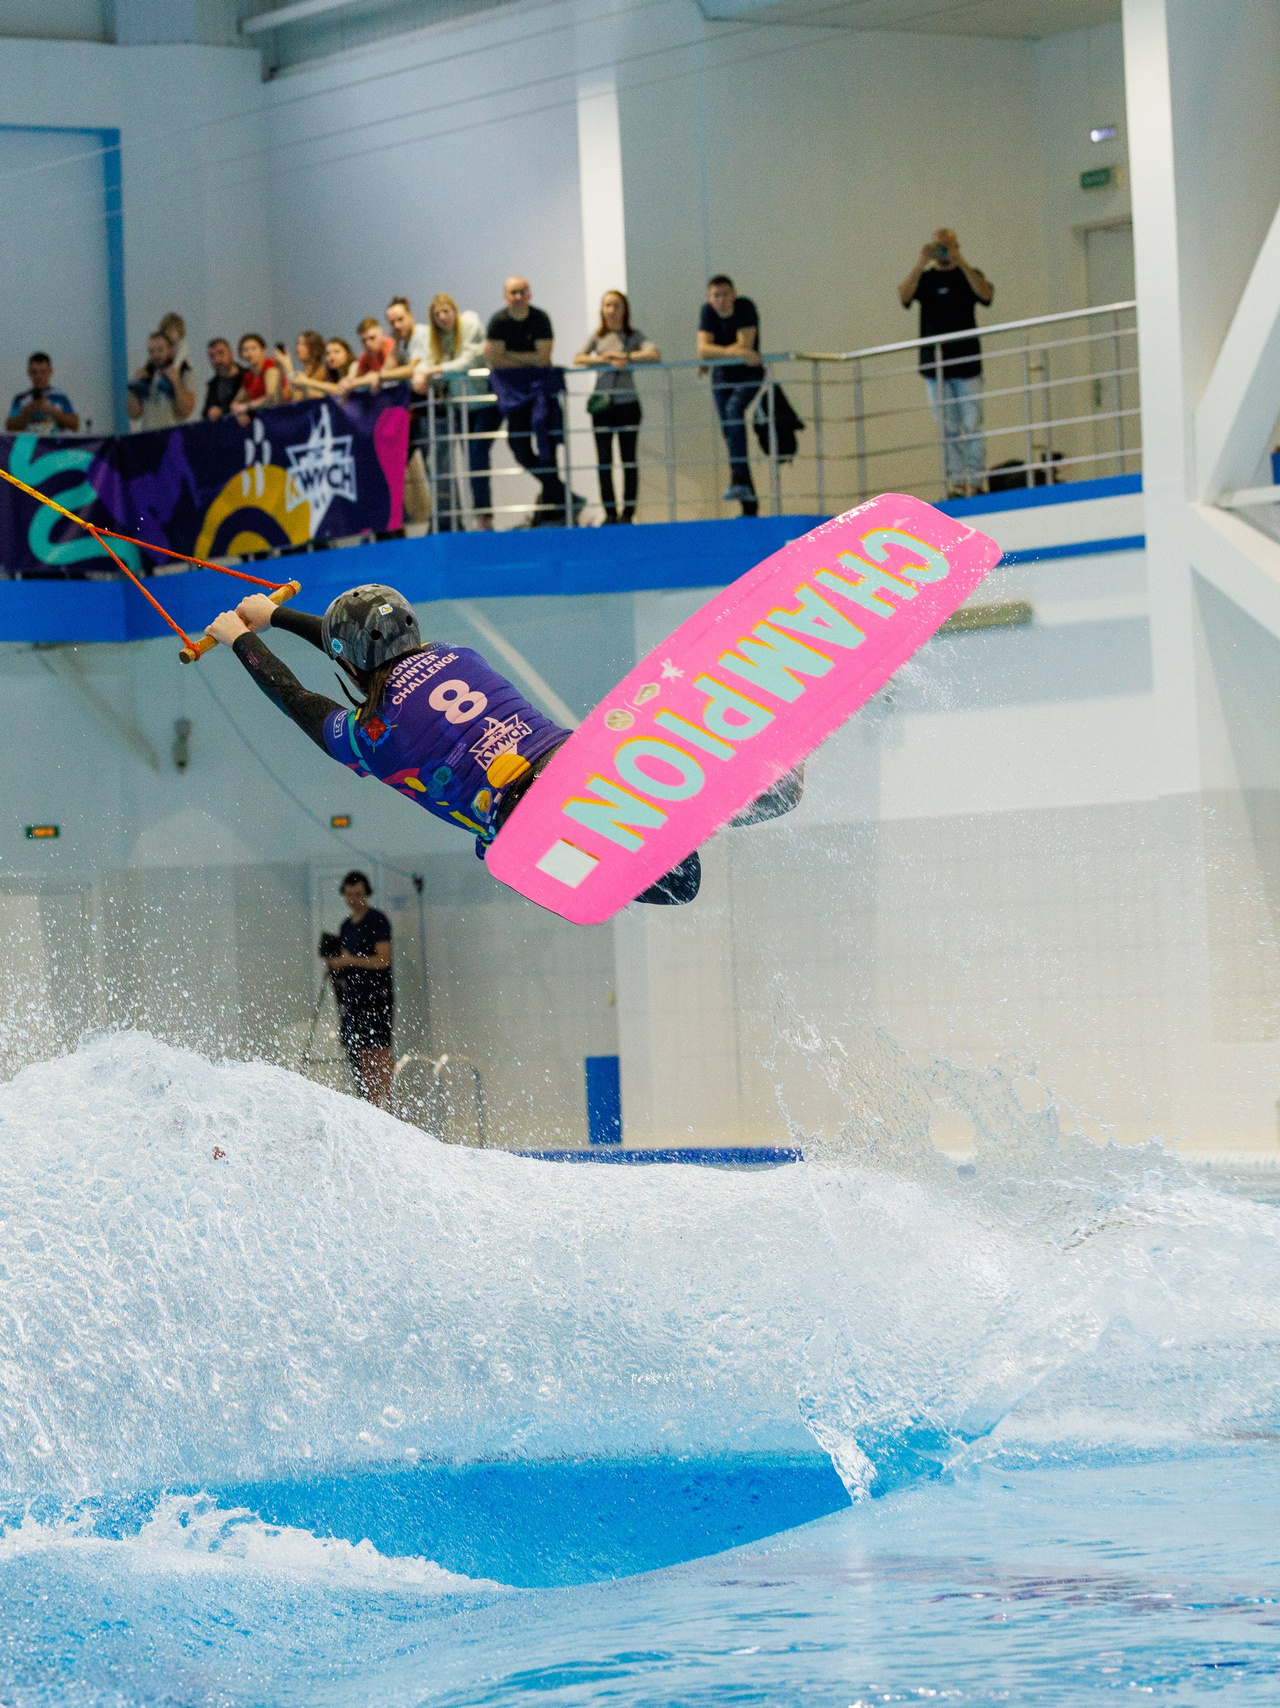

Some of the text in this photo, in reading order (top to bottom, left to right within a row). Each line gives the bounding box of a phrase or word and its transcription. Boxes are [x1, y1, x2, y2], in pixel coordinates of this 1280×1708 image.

[391, 652, 460, 706] CHALLENGE
[392, 653, 440, 689] WINTER
[561, 526, 950, 854] CHAMPION
[428, 679, 488, 725] 8
